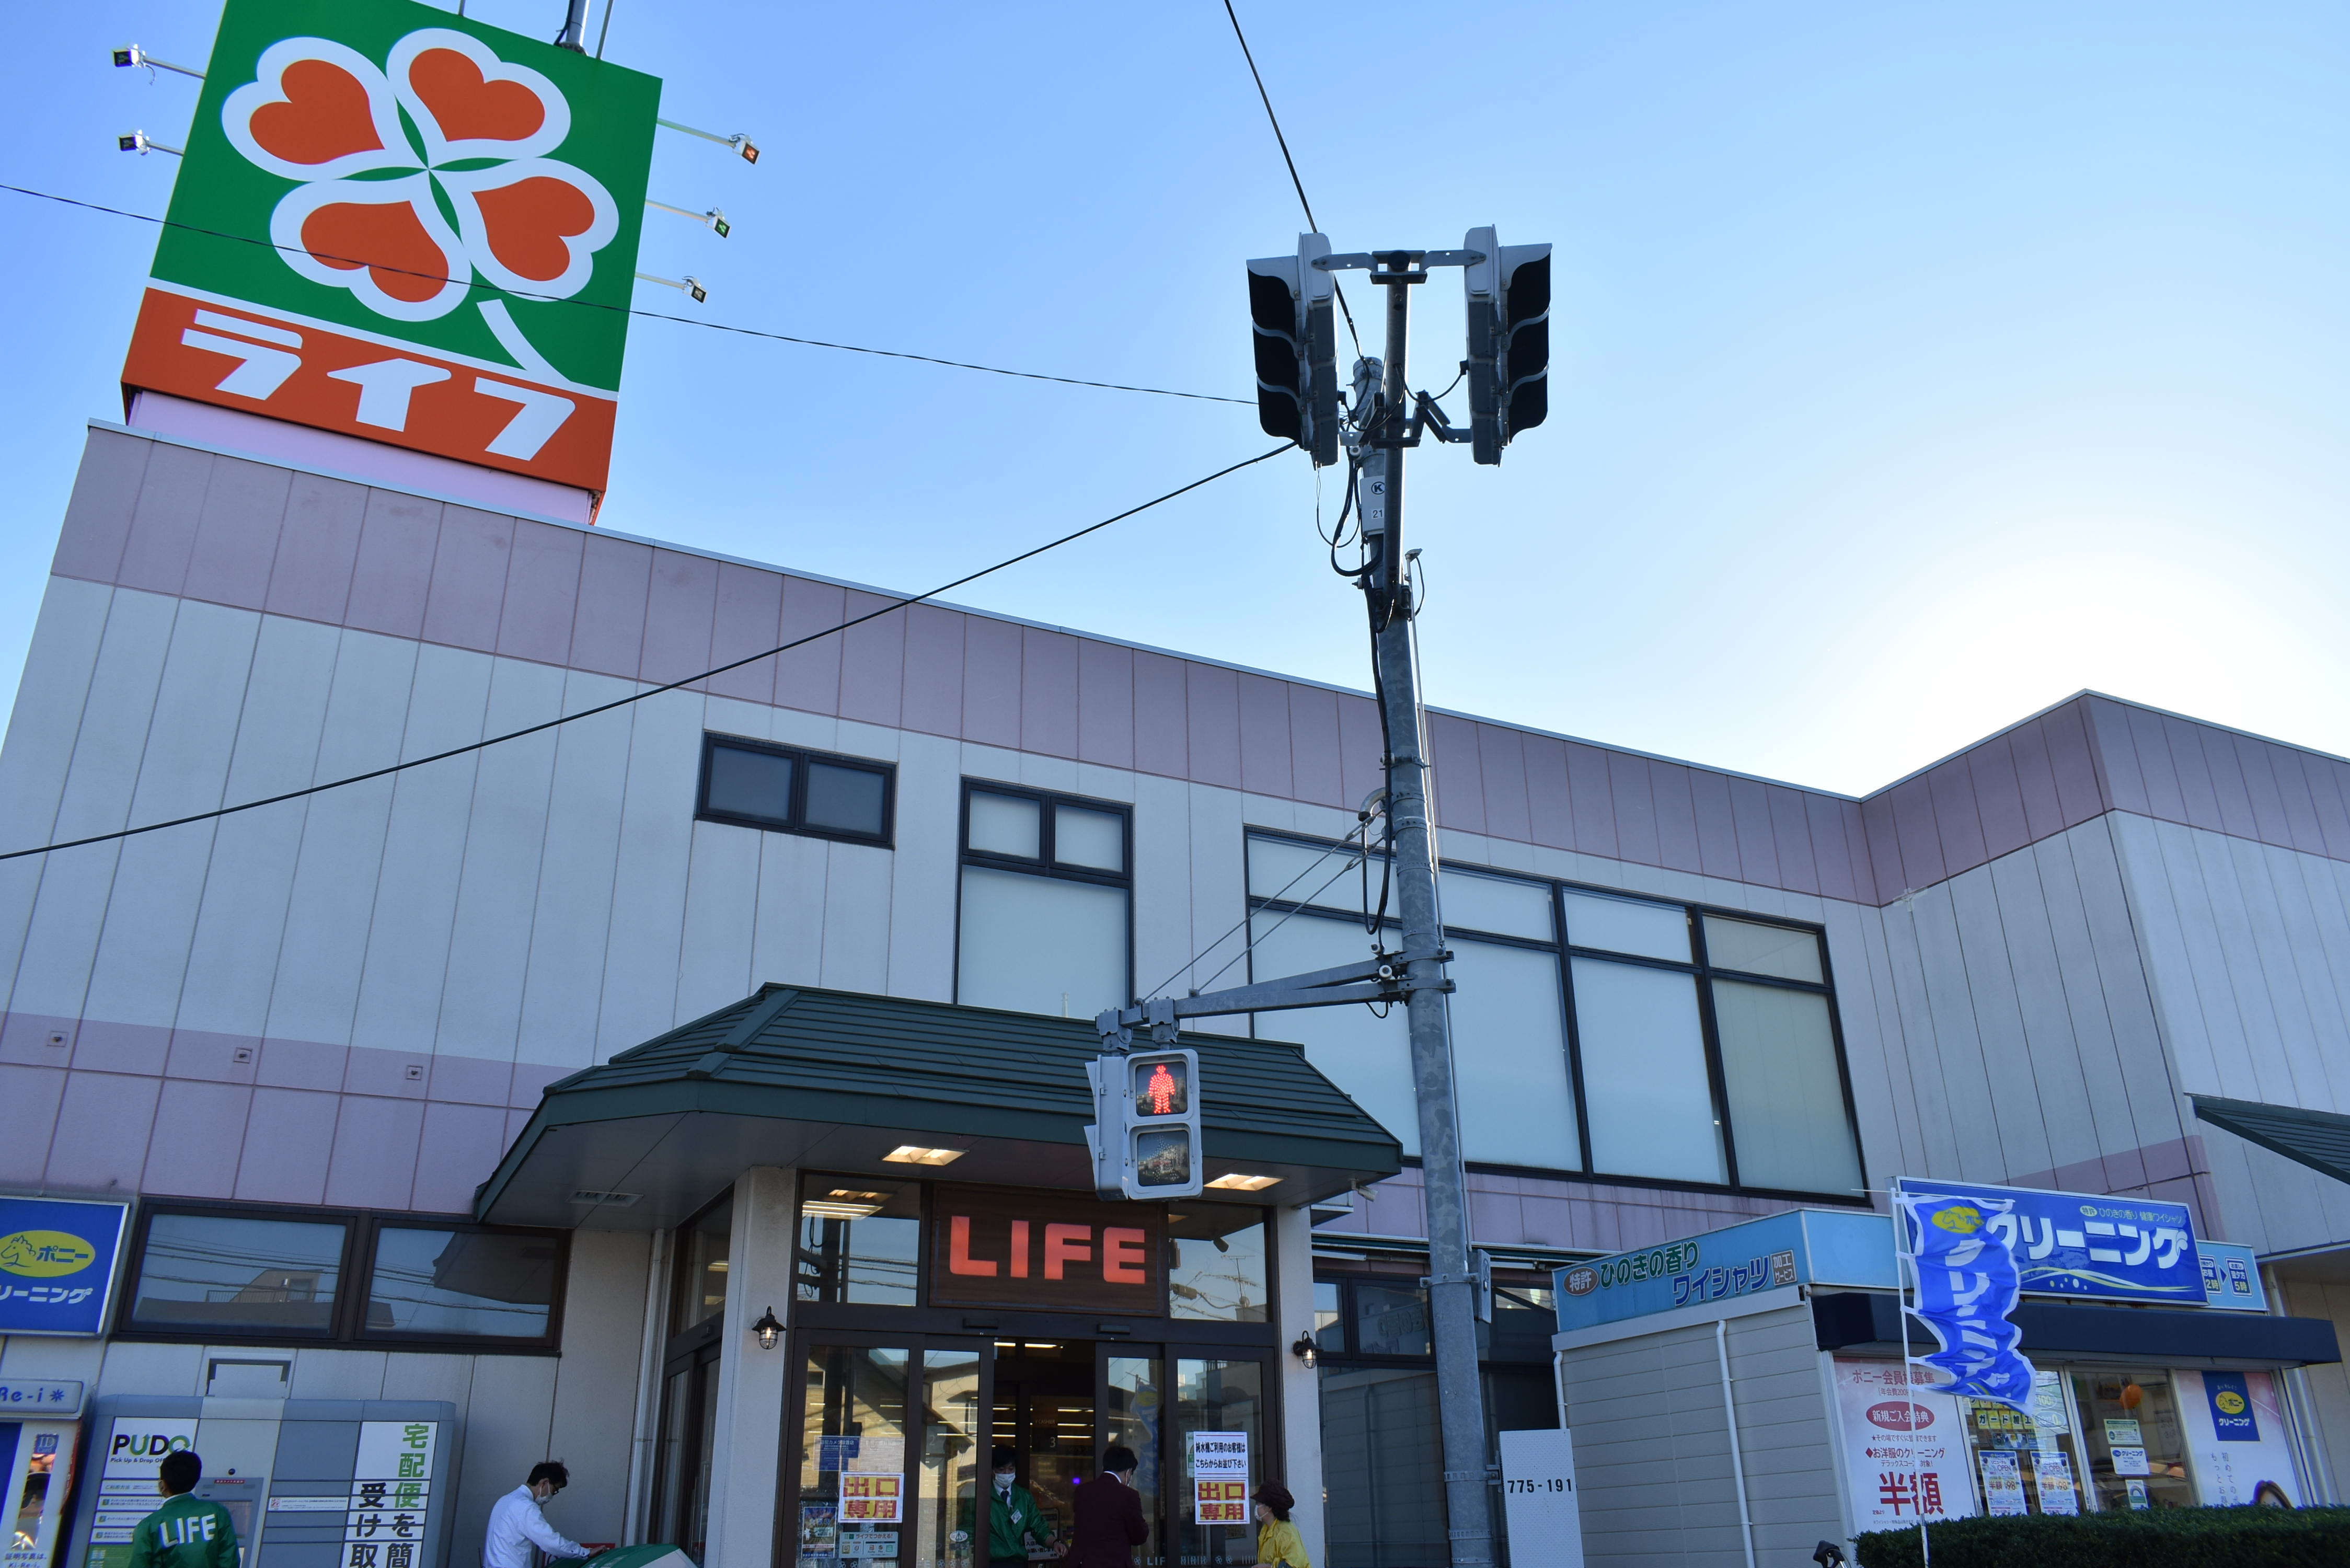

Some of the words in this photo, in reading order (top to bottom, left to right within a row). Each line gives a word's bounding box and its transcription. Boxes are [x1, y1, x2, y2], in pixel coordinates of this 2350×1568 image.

[181, 308, 575, 460] ライフ
[1373, 510, 1383, 518] 21
[2099, 1208, 2137, 1219] ひのきの香り
[2139, 1210, 2182, 1224] 健康ワイシャツ
[1990, 1214, 2188, 1269] クリーニング
[36, 1246, 89, 1263] ポニー
[950, 1215, 1145, 1284] LIFE
[1600, 1240, 1699, 1289] ひのきの香り
[1773, 1253, 1792, 1268] 加工
[1569, 1271, 1591, 1292] 特許
[1673, 1255, 1770, 1307] ワイシャツ
[1774, 1270, 1794, 1284] サービス
[2205, 1279, 2219, 1289] 2時
[2234, 1281, 2247, 1292] 5時
[1852, 1370, 1935, 1385] ポニー会員様募集
[1878, 1388, 1915, 1397] [年会費200]
[2228, 1398, 2242, 1406] ポニー
[1872, 1410, 1930, 1423] 新規ご入会特典
[1979, 1414, 2032, 1426] ガード加工
[2219, 1418, 2250, 1426] クリーニング
[112, 1434, 191, 1456] PUDO
[1050, 1437, 1056, 1448] 3
[1195, 1443, 1246, 1454] 純水機ご利用のお客様は
[1195, 1459, 1246, 1469] こちらからお並び下さい
[843, 1477, 900, 1497] 出口
[1198, 1482, 1245, 1501] 出口
[1507, 1479, 1572, 1493] 775-191
[1989, 1481, 2002, 1490] 半額
[2042, 1481, 2055, 1490] 半額
[387, 1423, 429, 1568] 宅配便を簡
[1879, 1471, 1944, 1516] 半額
[844, 1500, 897, 1518] 専用
[1200, 1503, 1244, 1520] 専用
[159, 1514, 216, 1549] LIFE
[349, 1482, 387, 1568] 受け取
[1147, 1557, 1166, 1565] LIF
